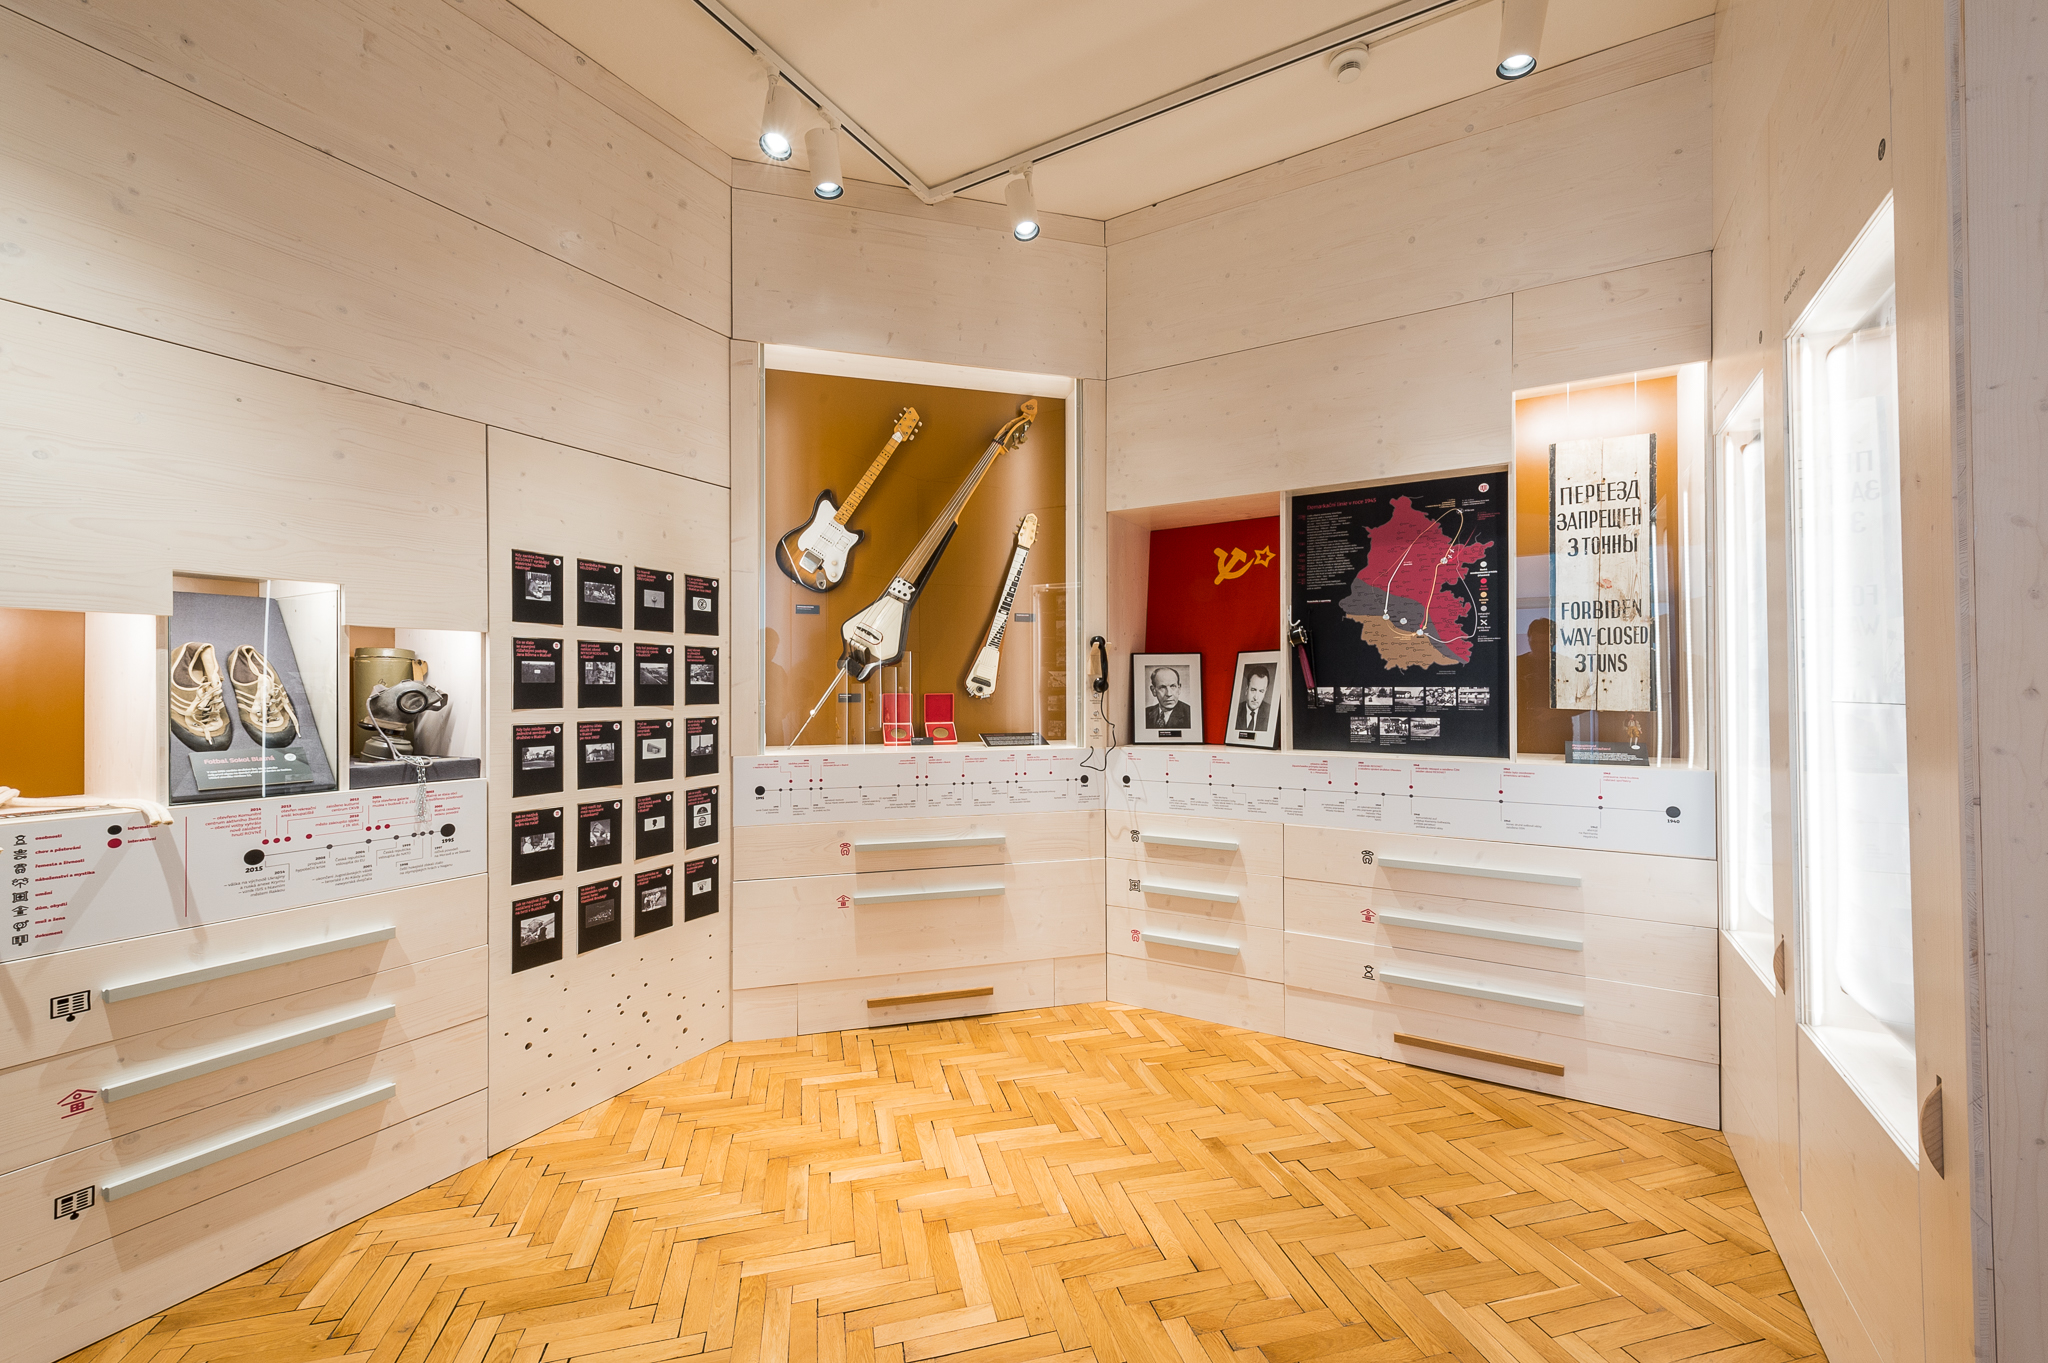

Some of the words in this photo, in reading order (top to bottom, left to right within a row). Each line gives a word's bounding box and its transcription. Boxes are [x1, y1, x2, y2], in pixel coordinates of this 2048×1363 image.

[1560, 480, 1640, 506] ПЕРЕЕЗД
[1556, 506, 1641, 531] ЗАПРЕЩЕН
[1568, 538, 1578, 556] 3
[1582, 534, 1638, 556] ТОННЫ
[1562, 598, 1642, 620] FORBIDEN
